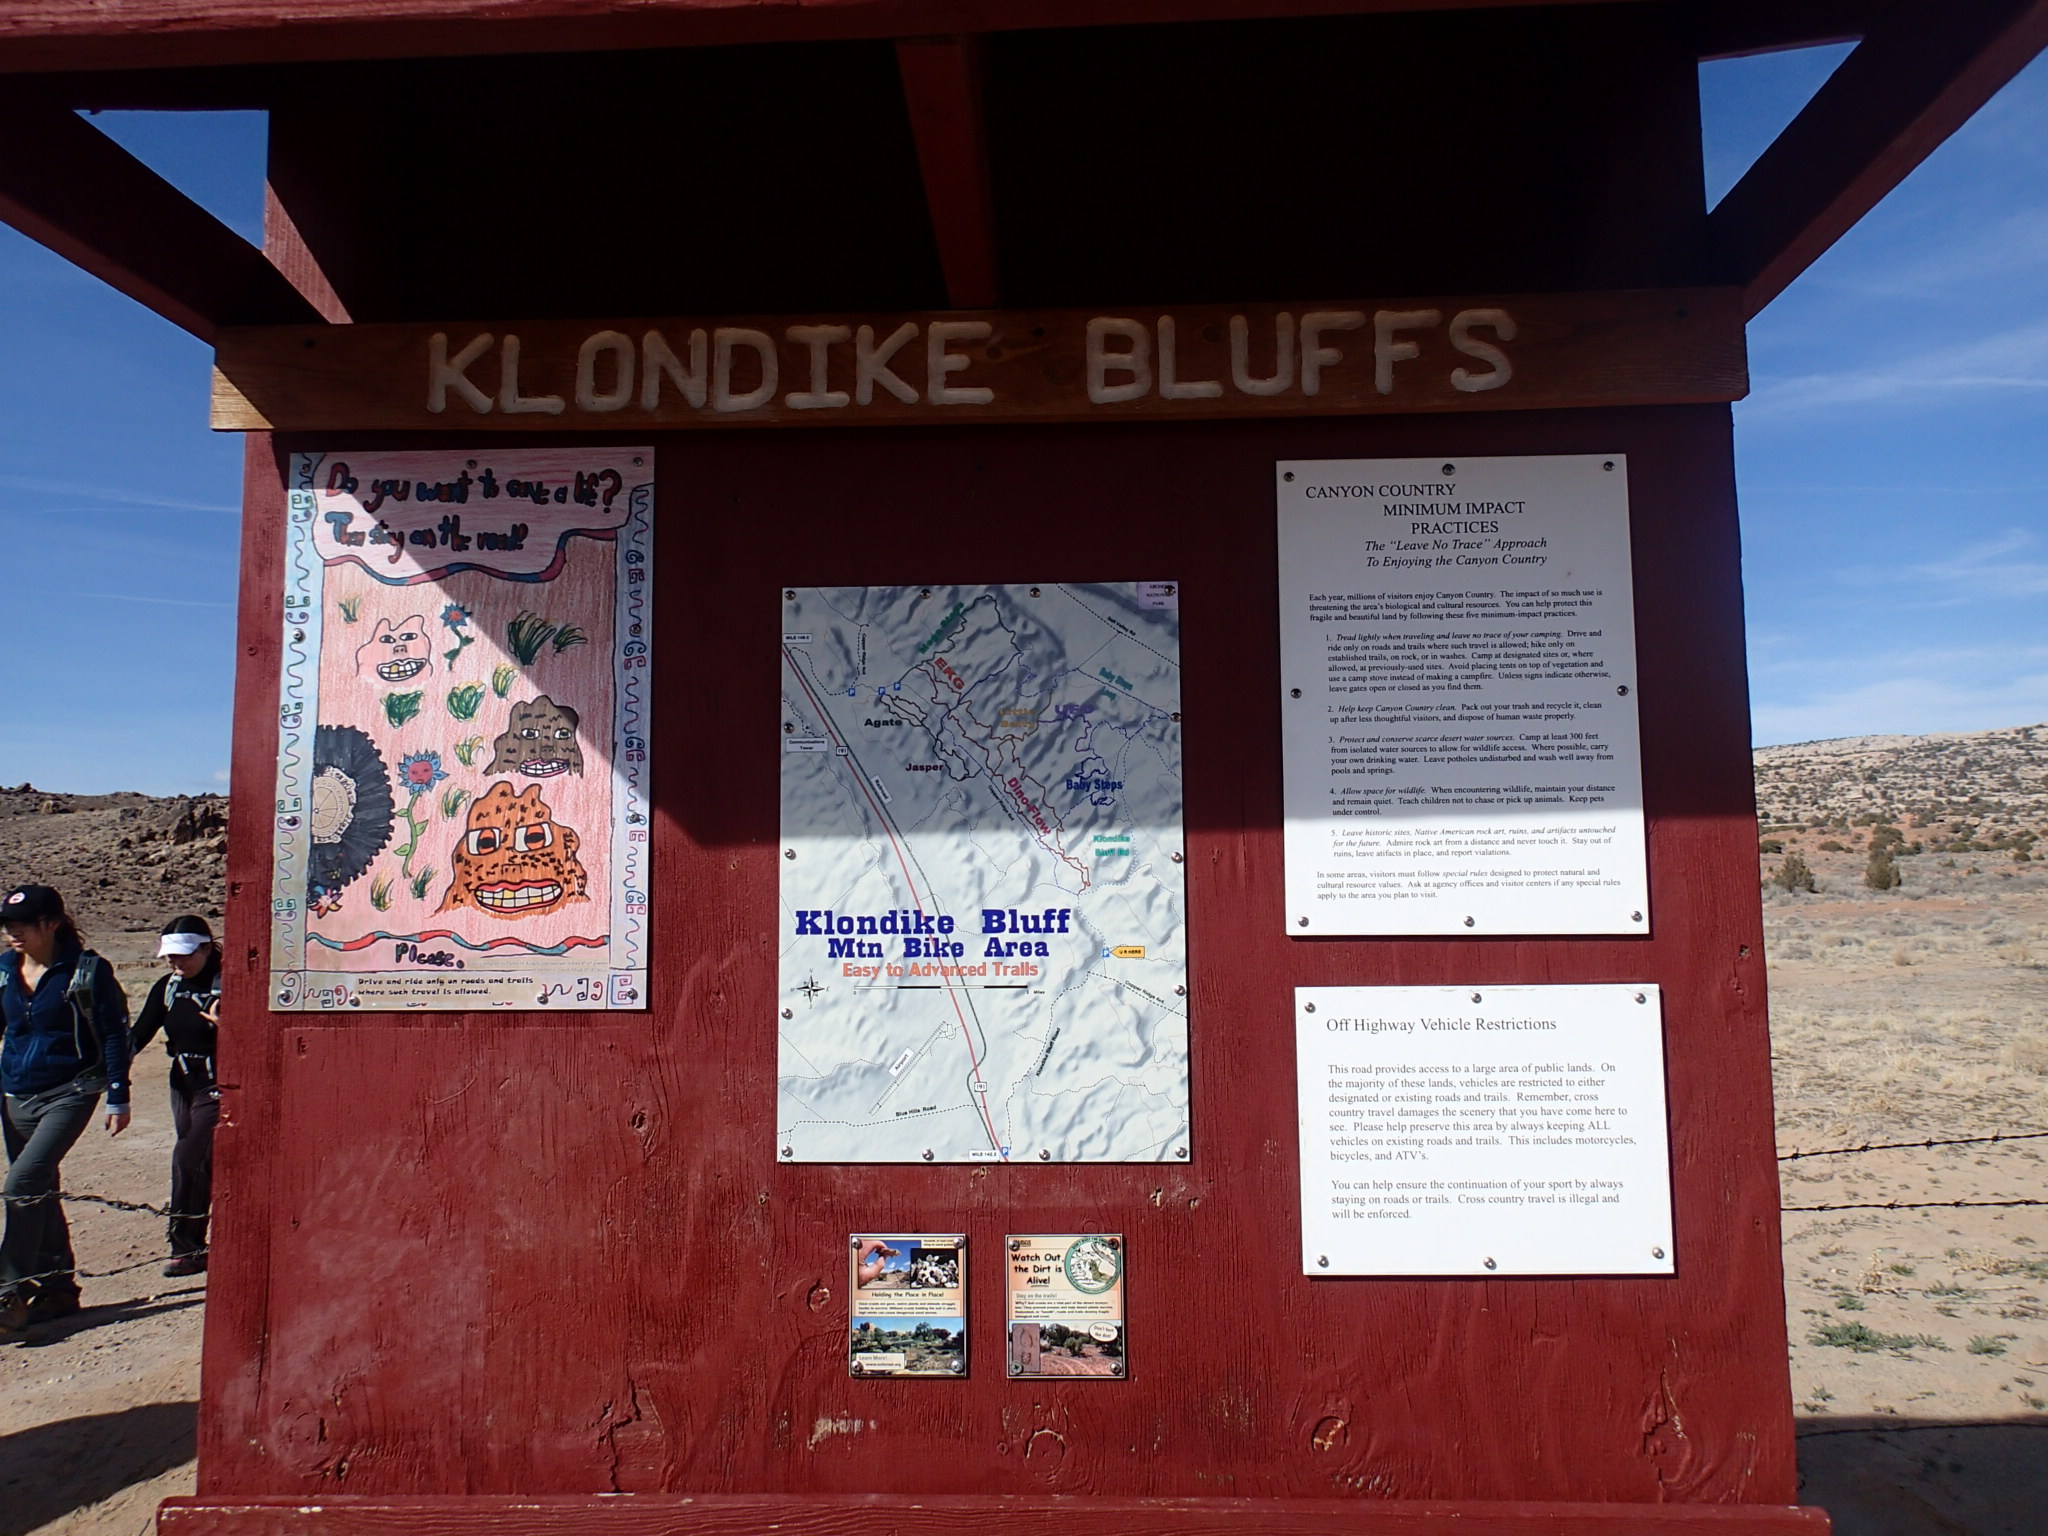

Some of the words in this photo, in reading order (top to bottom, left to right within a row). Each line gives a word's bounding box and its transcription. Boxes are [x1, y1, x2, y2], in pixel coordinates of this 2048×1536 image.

[428, 322, 995, 414] KLONDIKE
[1086, 309, 1517, 404] BLUFFS
[326, 462, 358, 497] Do
[363, 479, 410, 513] you
[416, 471, 473, 504] want
[479, 468, 499, 499] to
[506, 480, 550, 505] save
[554, 485, 568, 504] a
[1305, 485, 1376, 498] CANYON
[1378, 483, 1456, 497] COUNTRY
[1383, 502, 1461, 517] MINIMUM
[1465, 501, 1525, 515] IMPACT
[1410, 520, 1498, 535] PRACTICES
[369, 520, 404, 564] stay
[410, 528, 436, 548] on
[438, 515, 472, 551] the
[1365, 540, 1385, 554] The
[1433, 539, 1448, 550] No
[1492, 537, 1547, 552] Approach
[1366, 556, 1379, 566] To
[1380, 554, 1432, 569] Enjoying
[1435, 554, 1452, 565] the
[1455, 553, 1498, 567] Canyon
[1501, 552, 1547, 566] Country
[935, 657, 965, 690] EKG
[1055, 705, 1094, 715] UFO
[1338, 705, 1355, 714] Help
[1356, 704, 1373, 713] keep
[1375, 704, 1402, 713] Canyon
[1404, 703, 1434, 712] Country
[1435, 703, 1456, 711] clean.
[1546, 701, 1572, 711] recycle
[1573, 701, 1581, 709] it,
[864, 718, 903, 728] Agate
[905, 763, 944, 773] Jasper
[1066, 779, 1091, 792] Baby
[1094, 779, 1123, 792] Steps
[1007, 777, 1051, 835] Dino-Flow
[796, 910, 955, 935] Klondike
[981, 909, 1071, 934] Bluff
[828, 938, 884, 958] Mtn
[903, 937, 964, 958] Bike
[984, 937, 1049, 958] Area
[396, 943, 465, 969] Please.
[842, 963, 881, 981] Easy
[886, 963, 903, 977] to
[909, 962, 987, 977] Advanced
[992, 961, 1039, 976] Trails
[427, 978, 445, 987] only
[1125, 980, 1142, 992] Copper
[1326, 1018, 1351, 1031] Off
[1354, 1017, 1415, 1034] Highway
[1420, 1017, 1470, 1030] Vehicle
[1475, 1016, 1556, 1030] Restrictions
[894, 1054, 909, 1071] Airport
[1327, 1064, 1348, 1073] This
[1351, 1064, 1372, 1073] road
[1375, 1064, 1416, 1075] provides
[1472, 1063, 1496, 1075] large
[1521, 1063, 1532, 1072] of
[1534, 1062, 1564, 1074] public
[1567, 1062, 1594, 1072] lands.
[1600, 1062, 1615, 1071] On
[1011, 1254, 1040, 1262] Watch
[1026, 1276, 1050, 1285] Alive!
